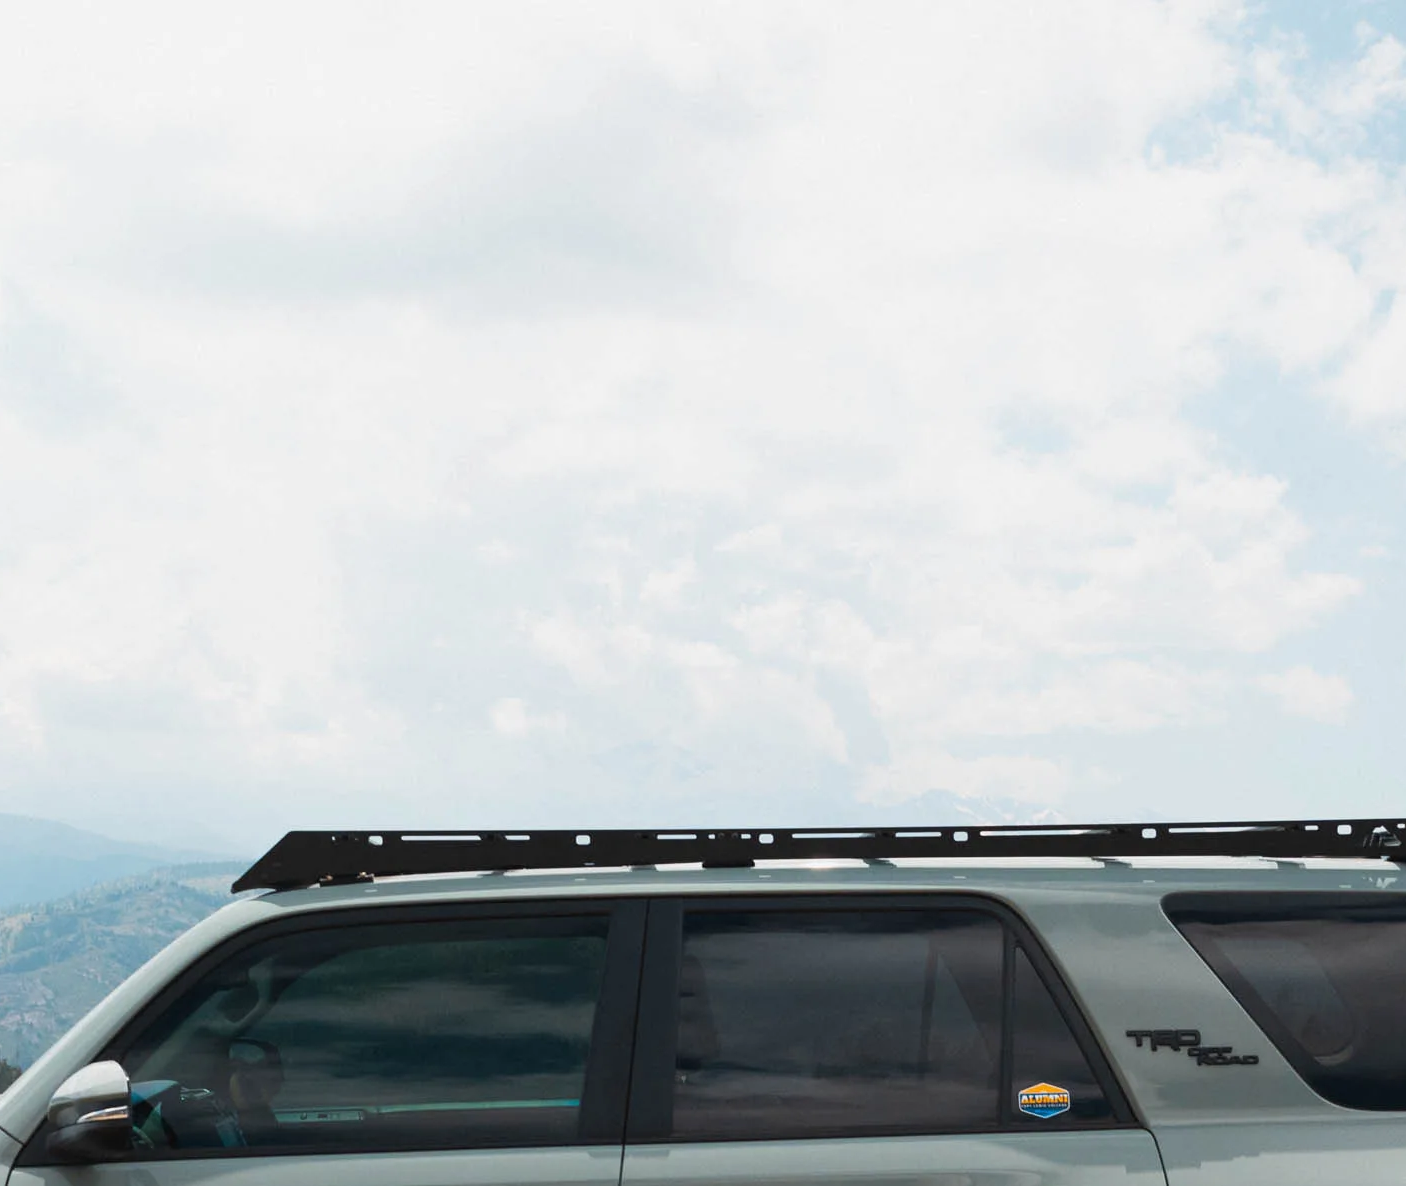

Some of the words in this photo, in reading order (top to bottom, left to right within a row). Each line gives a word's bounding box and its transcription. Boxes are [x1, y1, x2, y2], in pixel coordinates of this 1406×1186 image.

[1126, 1029, 1201, 1052] TRD
[1187, 1047, 1233, 1057] OFF
[1197, 1055, 1260, 1066] ROAD
[1020, 1094, 1068, 1104] ALUMNI
